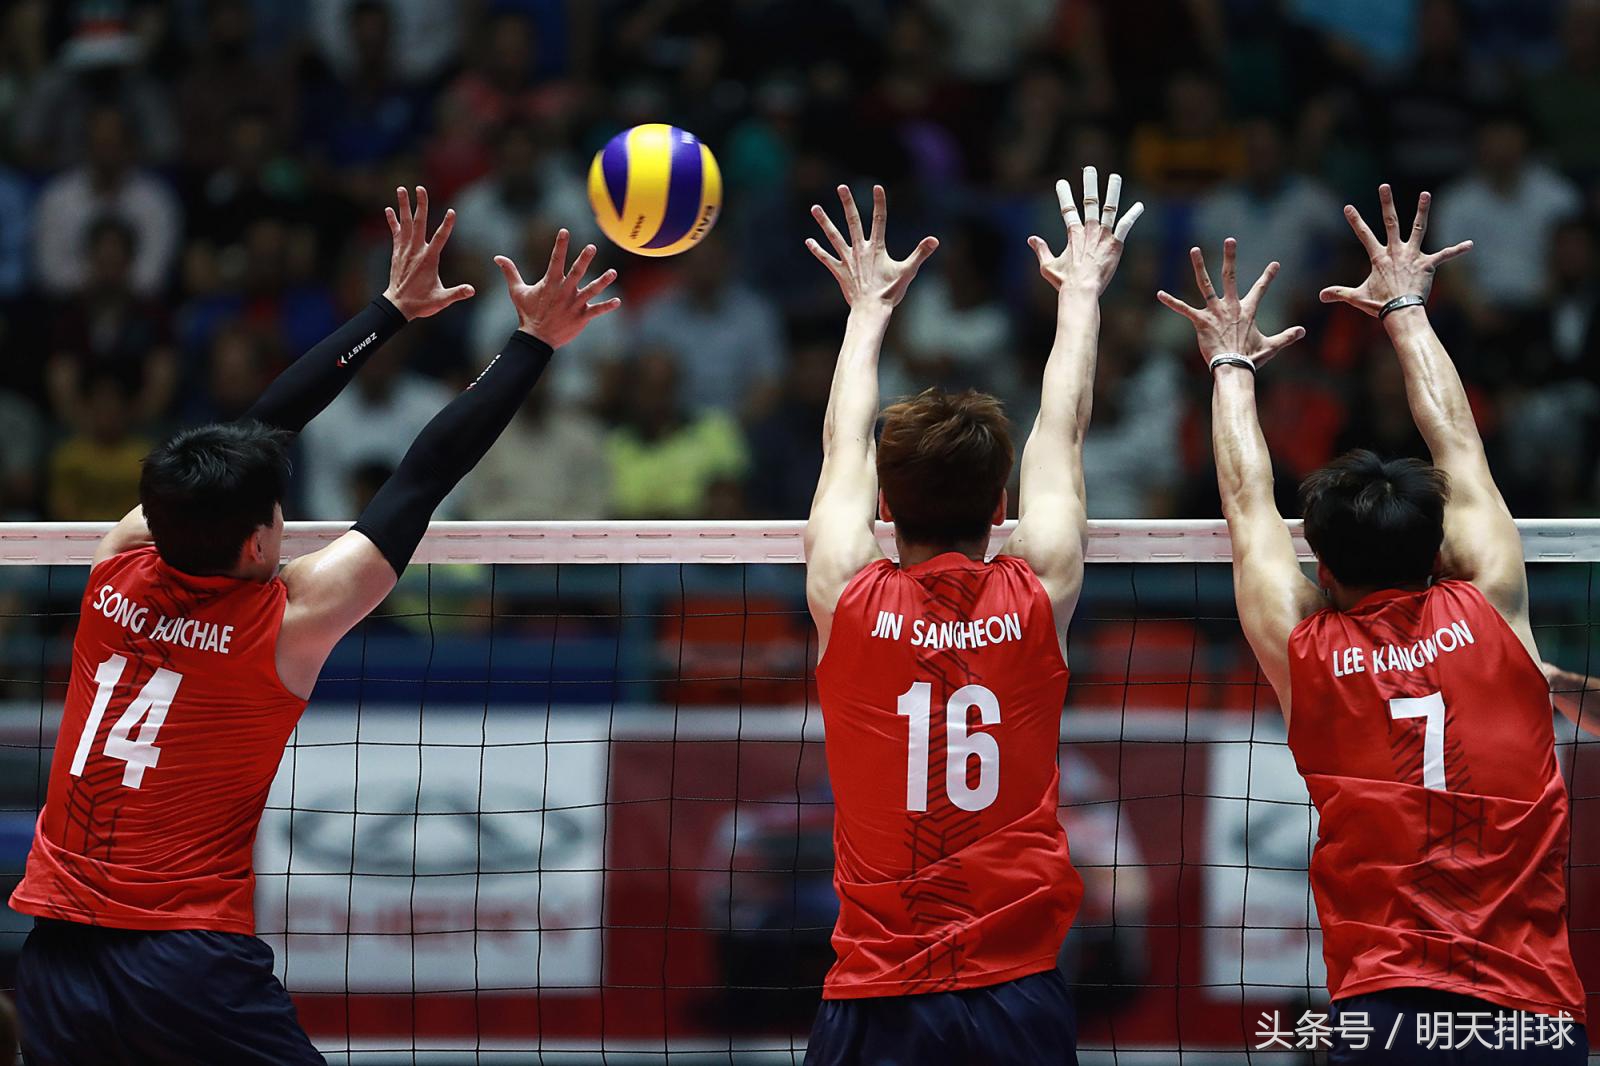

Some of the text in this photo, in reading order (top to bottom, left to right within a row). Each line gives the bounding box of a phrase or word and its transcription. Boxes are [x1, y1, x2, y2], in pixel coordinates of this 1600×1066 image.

[93, 585, 234, 654] SONG HUICHAE
[871, 610, 1022, 650] JIN SANGHEON
[1333, 619, 1475, 677] LEE KANGWON
[69, 653, 183, 790] 14
[897, 681, 1001, 812] 16
[1389, 691, 1447, 791] 7
